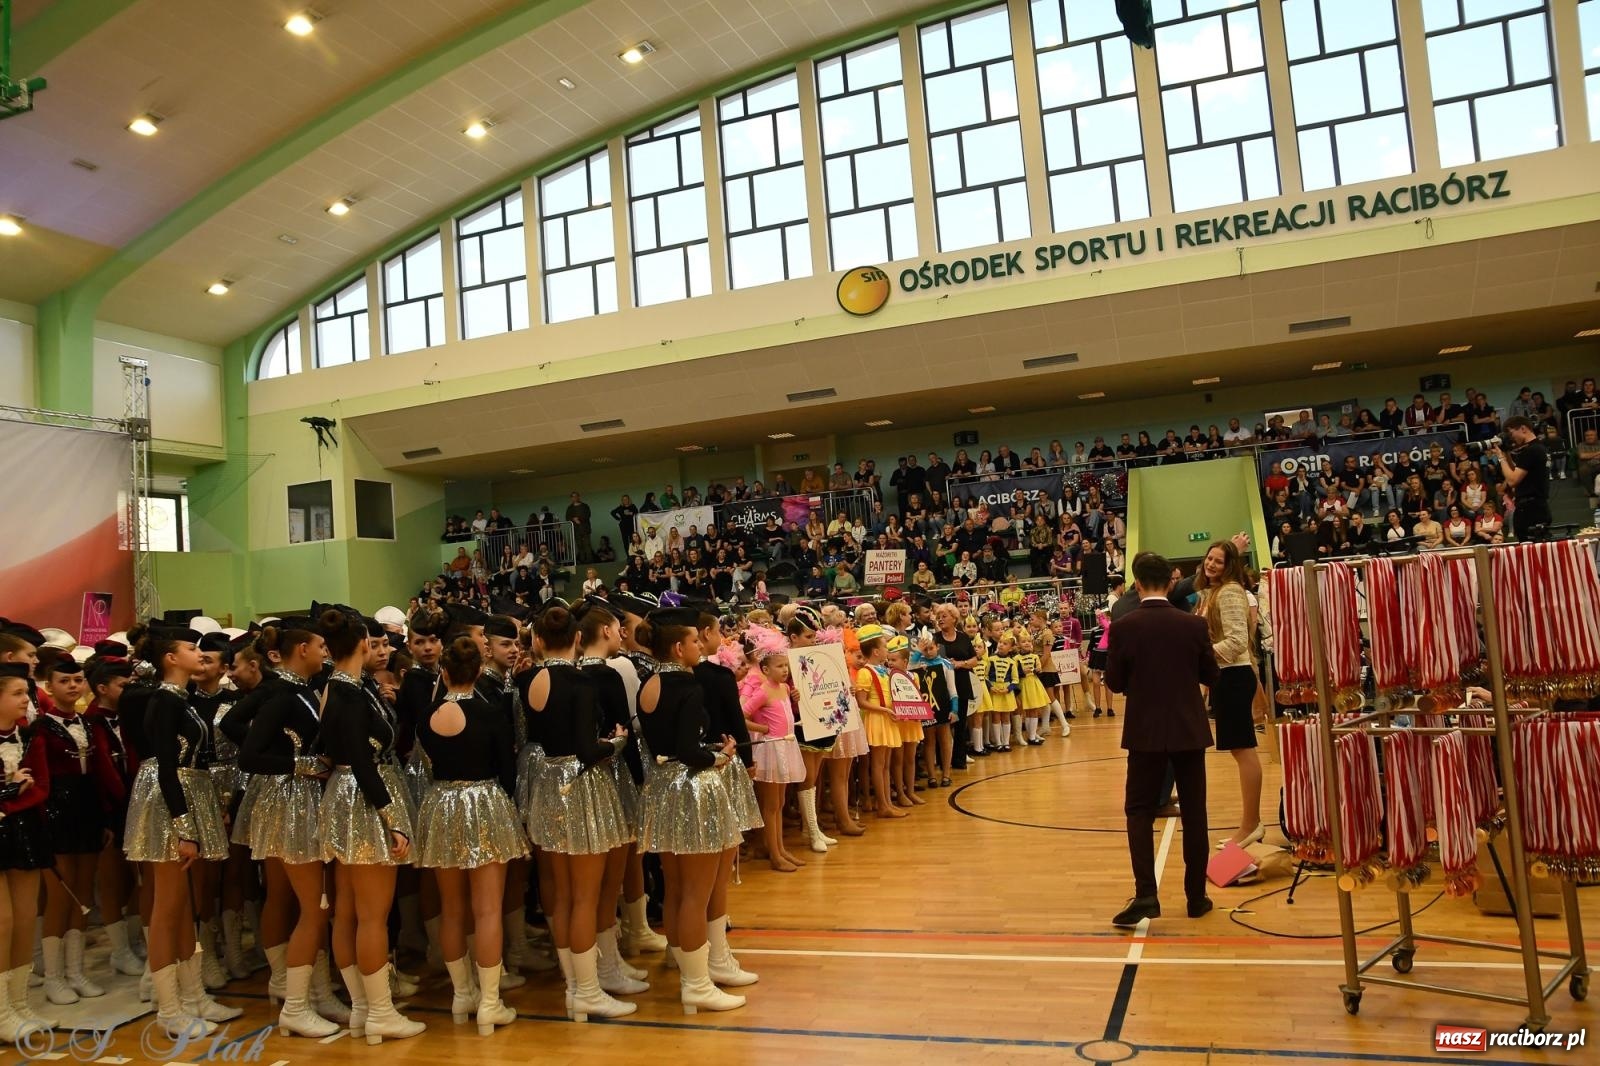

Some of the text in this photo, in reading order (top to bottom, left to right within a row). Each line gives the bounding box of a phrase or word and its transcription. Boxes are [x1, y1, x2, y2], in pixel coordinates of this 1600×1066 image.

[900, 170, 1512, 292] OŚRODEK SPORTU I REKREACJI RACIBÓRZ
[731, 509, 777, 529] CHARMS
[869, 560, 903, 571] PANTERY
